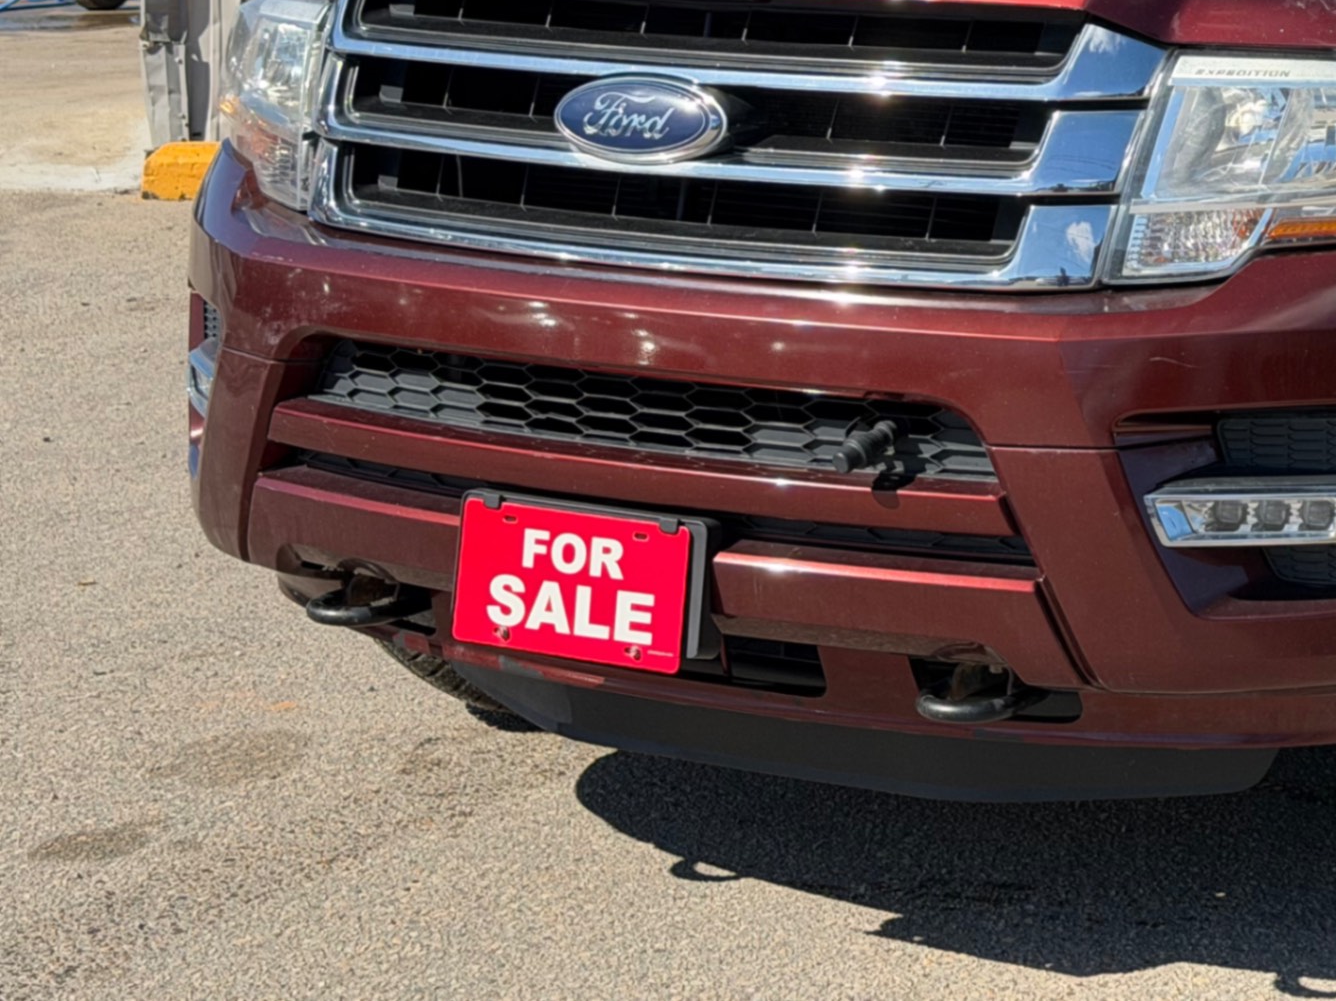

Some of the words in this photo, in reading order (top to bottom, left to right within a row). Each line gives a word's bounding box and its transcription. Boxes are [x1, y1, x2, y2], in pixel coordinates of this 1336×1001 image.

[1194, 68, 1292, 78] EXPEDITION
[582, 90, 676, 140] Ford
[521, 527, 625, 581] FOR
[486, 573, 656, 646] SALE
